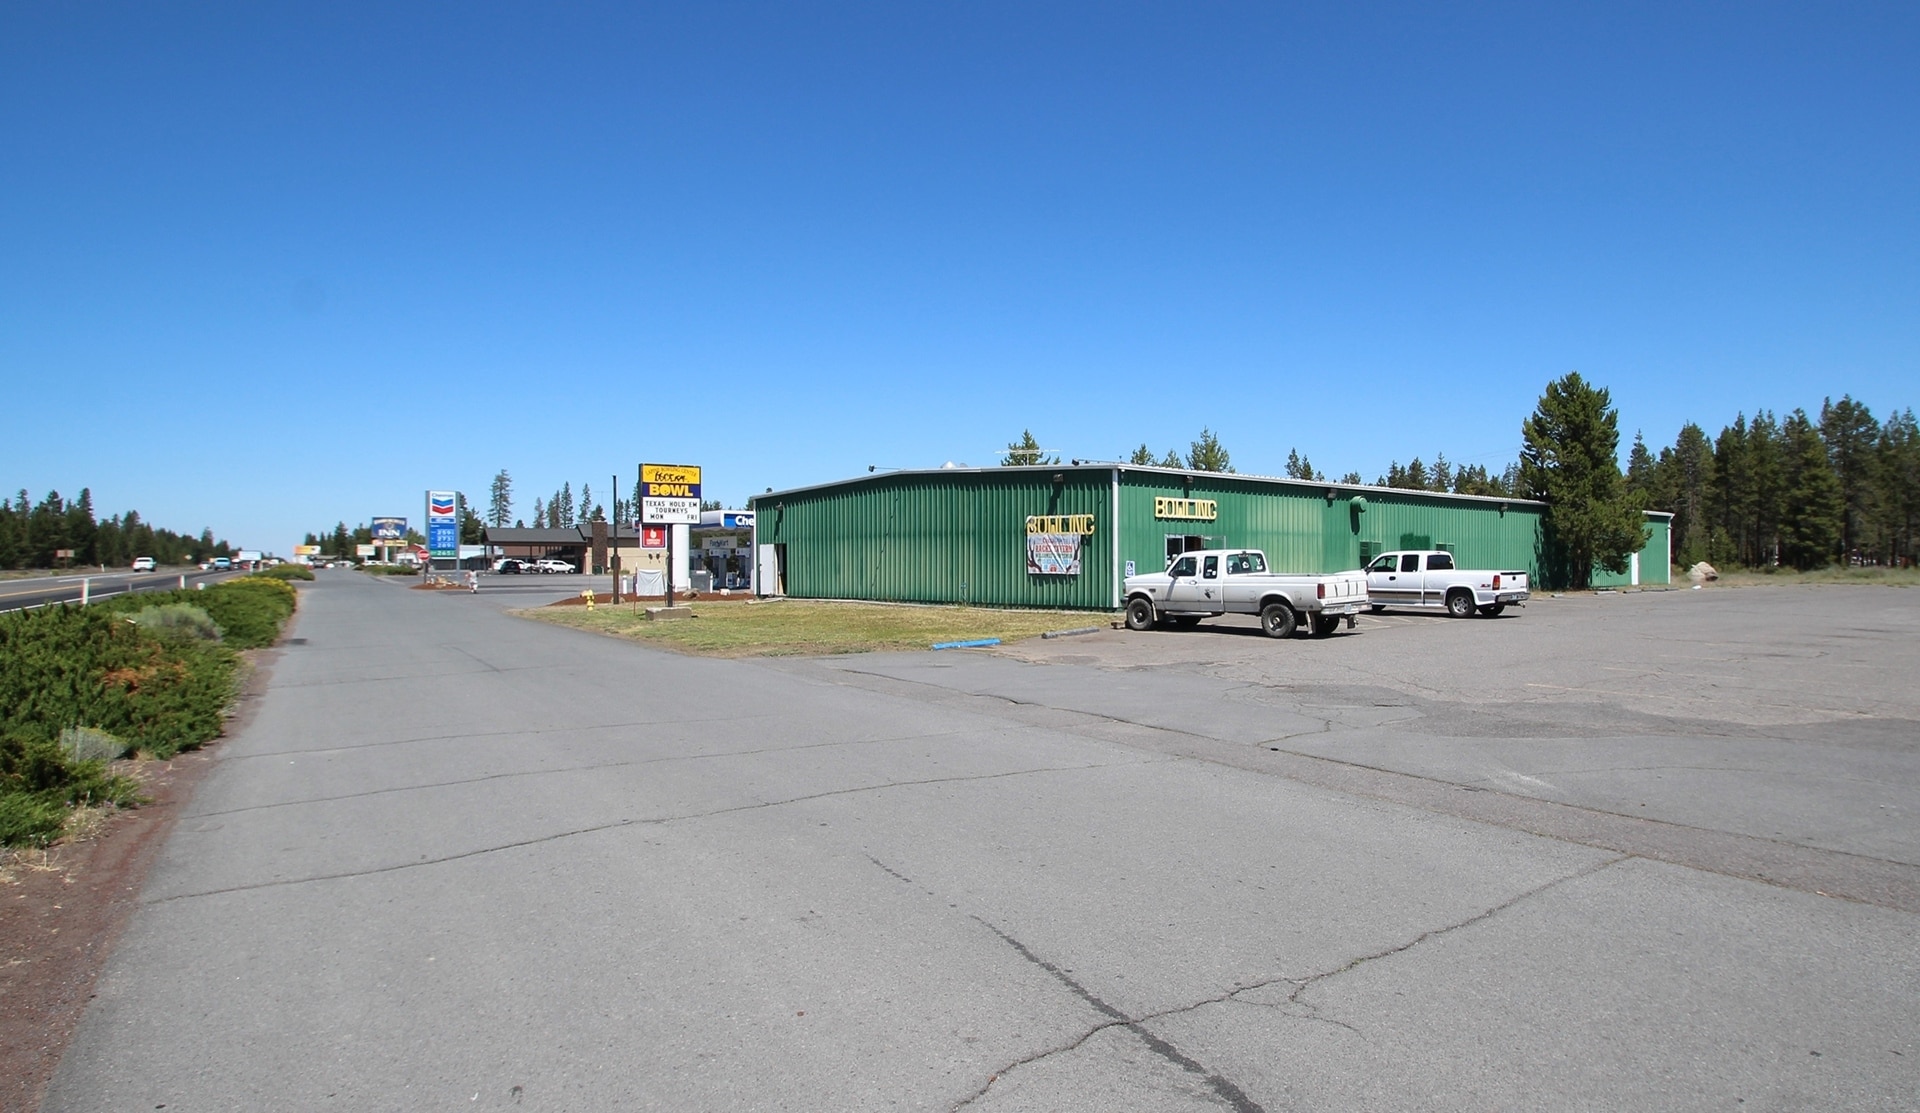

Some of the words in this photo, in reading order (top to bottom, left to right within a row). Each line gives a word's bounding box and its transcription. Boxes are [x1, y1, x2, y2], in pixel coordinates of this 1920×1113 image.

[649, 484, 694, 497] BOWL
[1154, 496, 1217, 520] BOWLING
[378, 528, 400, 537] INN
[1026, 515, 1095, 535] BOWLING
